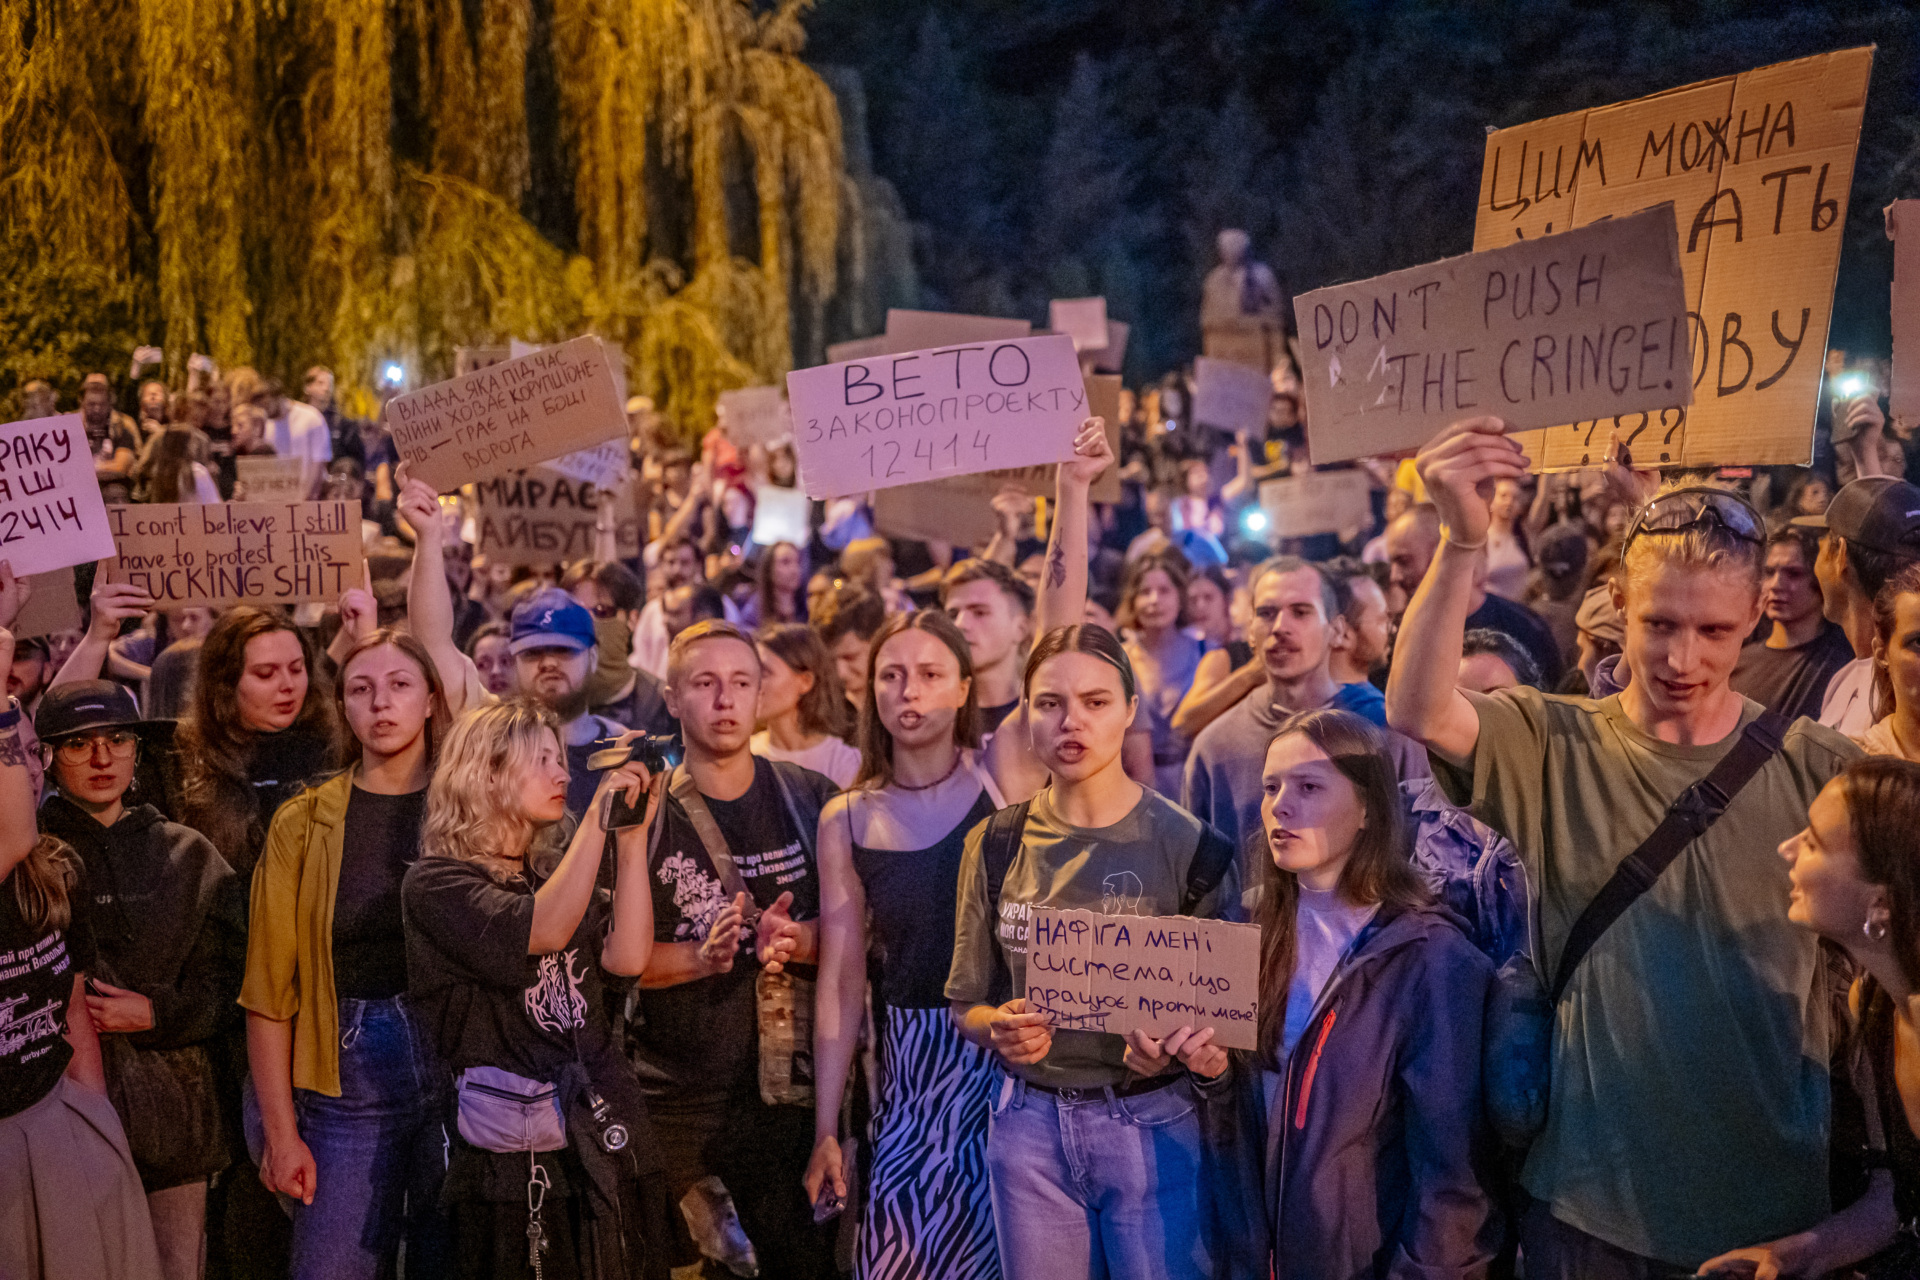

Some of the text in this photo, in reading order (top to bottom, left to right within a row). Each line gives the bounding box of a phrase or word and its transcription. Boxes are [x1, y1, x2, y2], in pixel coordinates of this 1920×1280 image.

[1489, 101, 1796, 221] ЦИМ МОЖНА
[1314, 254, 1606, 351] DON'T PUSH
[465, 374, 499, 399] ЯКА
[501, 361, 535, 387] ПІД
[534, 349, 569, 371] ЧАС
[844, 344, 1031, 406] ВЕТО
[1385, 316, 1678, 416] THE CRINGE!
[394, 416, 443, 447] ВІЙНИ
[445, 391, 508, 427] ХОВАЄ
[455, 416, 498, 445] ГРАЄ
[507, 405, 531, 430] НА
[542, 389, 587, 416] БОЦІ
[806, 387, 1086, 443] ЗАКОНОПРОЄКТУ
[462, 430, 535, 471] ВОРОГА
[861, 429, 991, 478] 12414
[0, 496, 83, 547] 2414
[110, 502, 349, 536] I can't believe I still
[118, 533, 333, 577] have to protest this
[18, 946, 35, 962] про
[1035, 916, 1131, 947] НАФІГА
[0, 963, 31, 980] наших
[1188, 970, 1231, 995] що
[1028, 985, 1258, 1023] працює проти мене?
